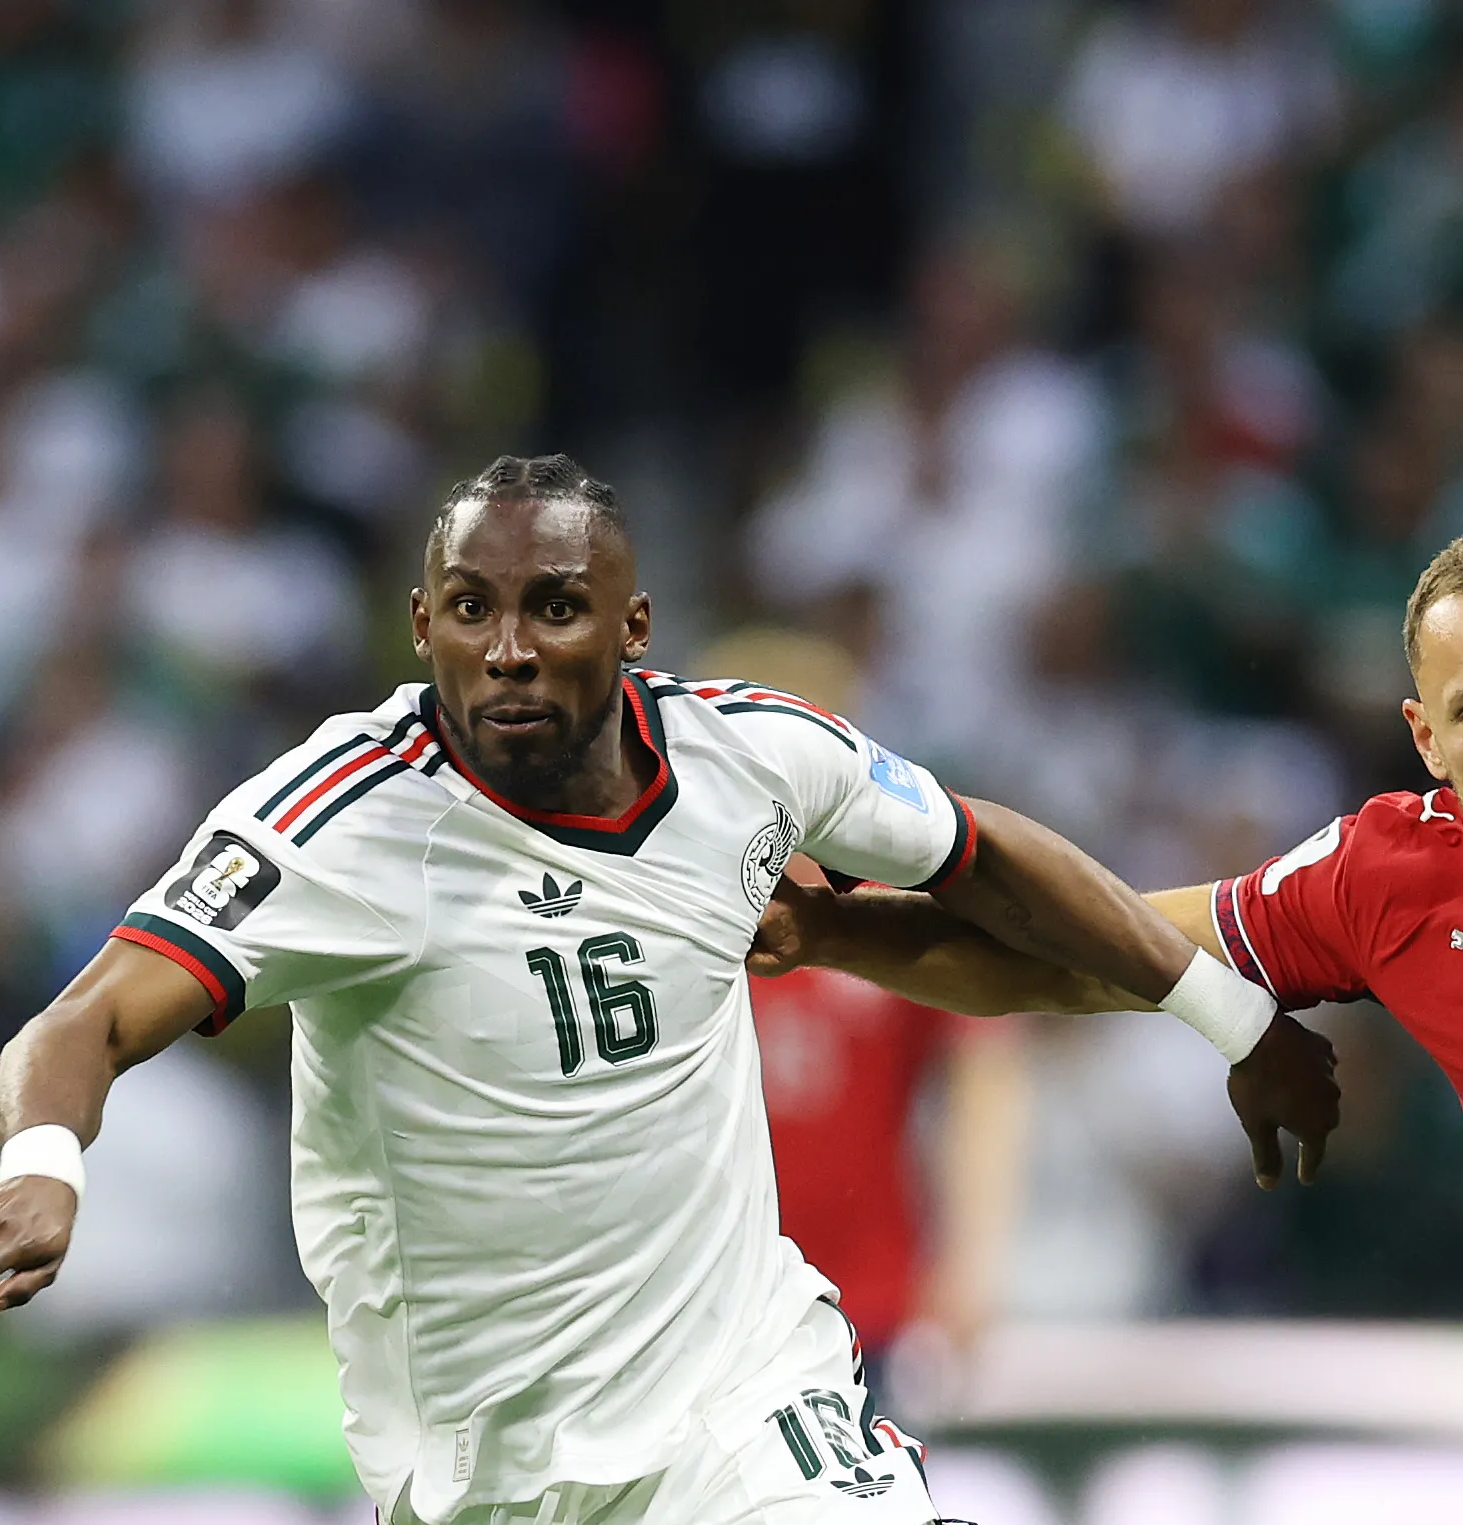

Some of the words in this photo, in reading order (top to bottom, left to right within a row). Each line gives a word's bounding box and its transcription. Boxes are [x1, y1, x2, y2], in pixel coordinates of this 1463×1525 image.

[176, 896, 213, 925] 2026
[525, 931, 660, 1078] 16
[764, 1388, 871, 1481] 16
